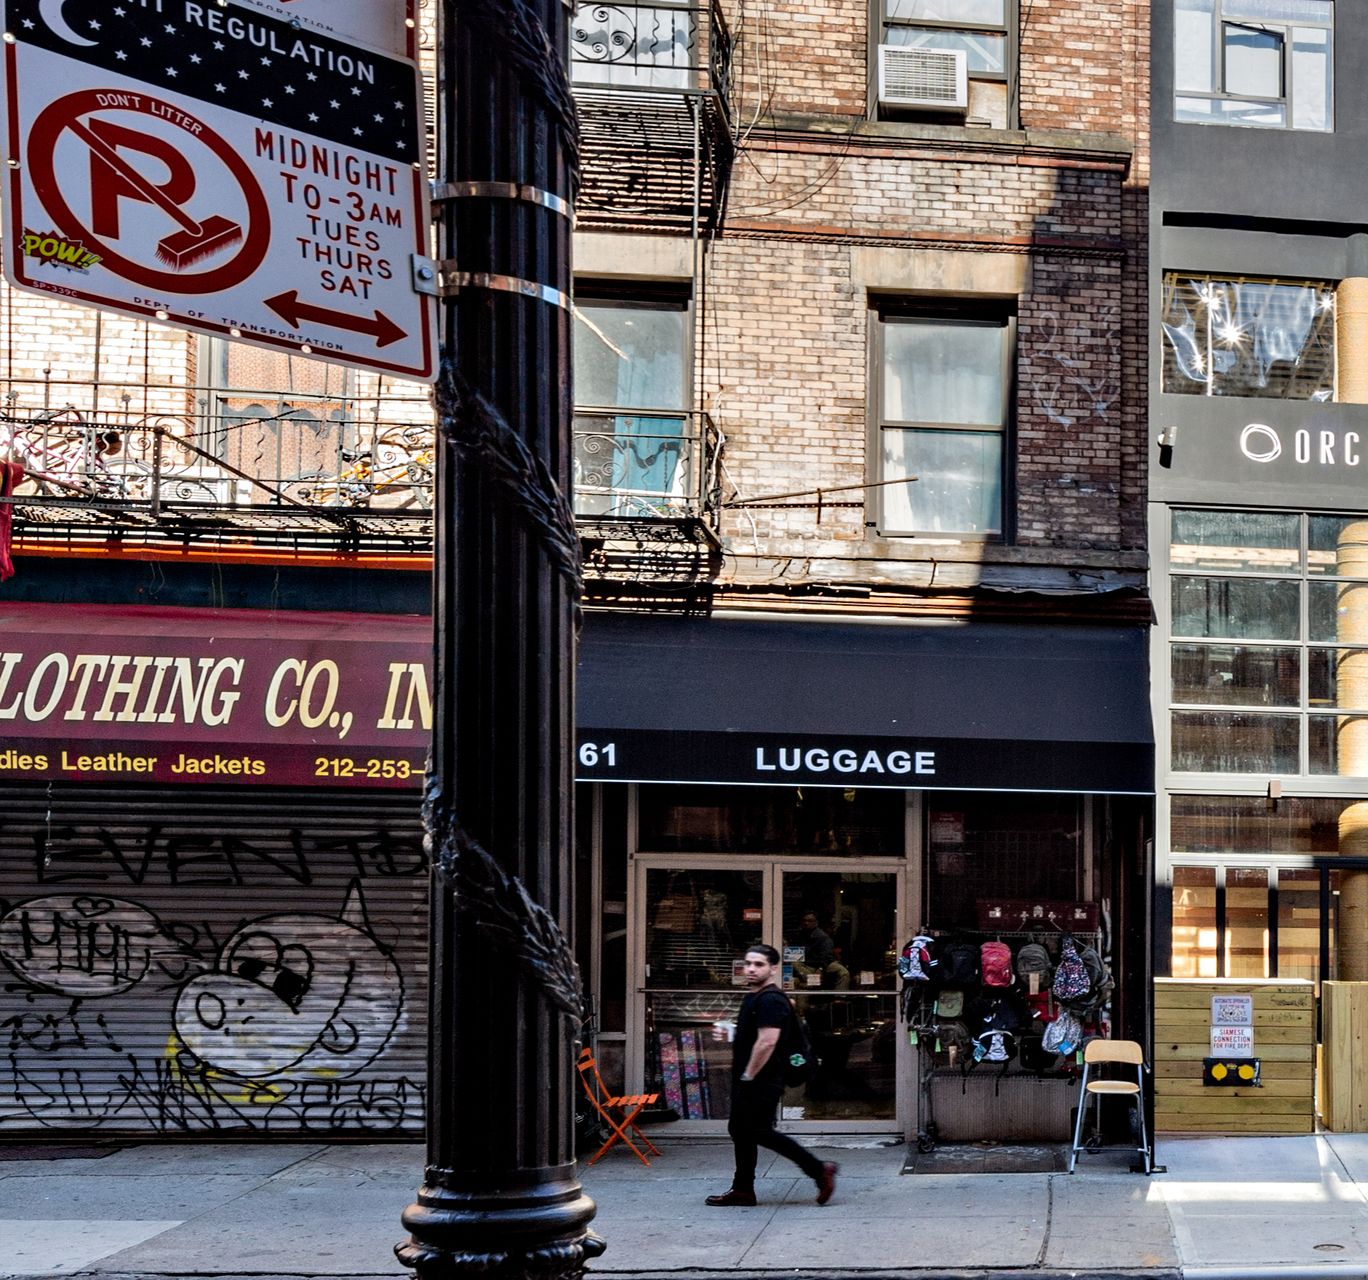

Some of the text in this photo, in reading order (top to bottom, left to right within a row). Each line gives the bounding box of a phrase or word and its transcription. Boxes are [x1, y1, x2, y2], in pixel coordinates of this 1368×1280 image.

[185, 1, 375, 85] REGULATION
[96, 93, 203, 135] DON'T LITTER
[255, 127, 397, 196] MIDNIGHT
[306, 214, 380, 252] TUES
[296, 237, 392, 280] THURS
[320, 270, 373, 300] SAT
[134, 297, 344, 352] DEPT OF TRANSPORTATION
[0, 651, 245, 727] LOTHING
[61, 752, 157, 773] Leather
[171, 754, 266, 776] Jackets
[315, 757, 427, 779] 212-253-
[756, 747, 936, 775] LUGGAGE
